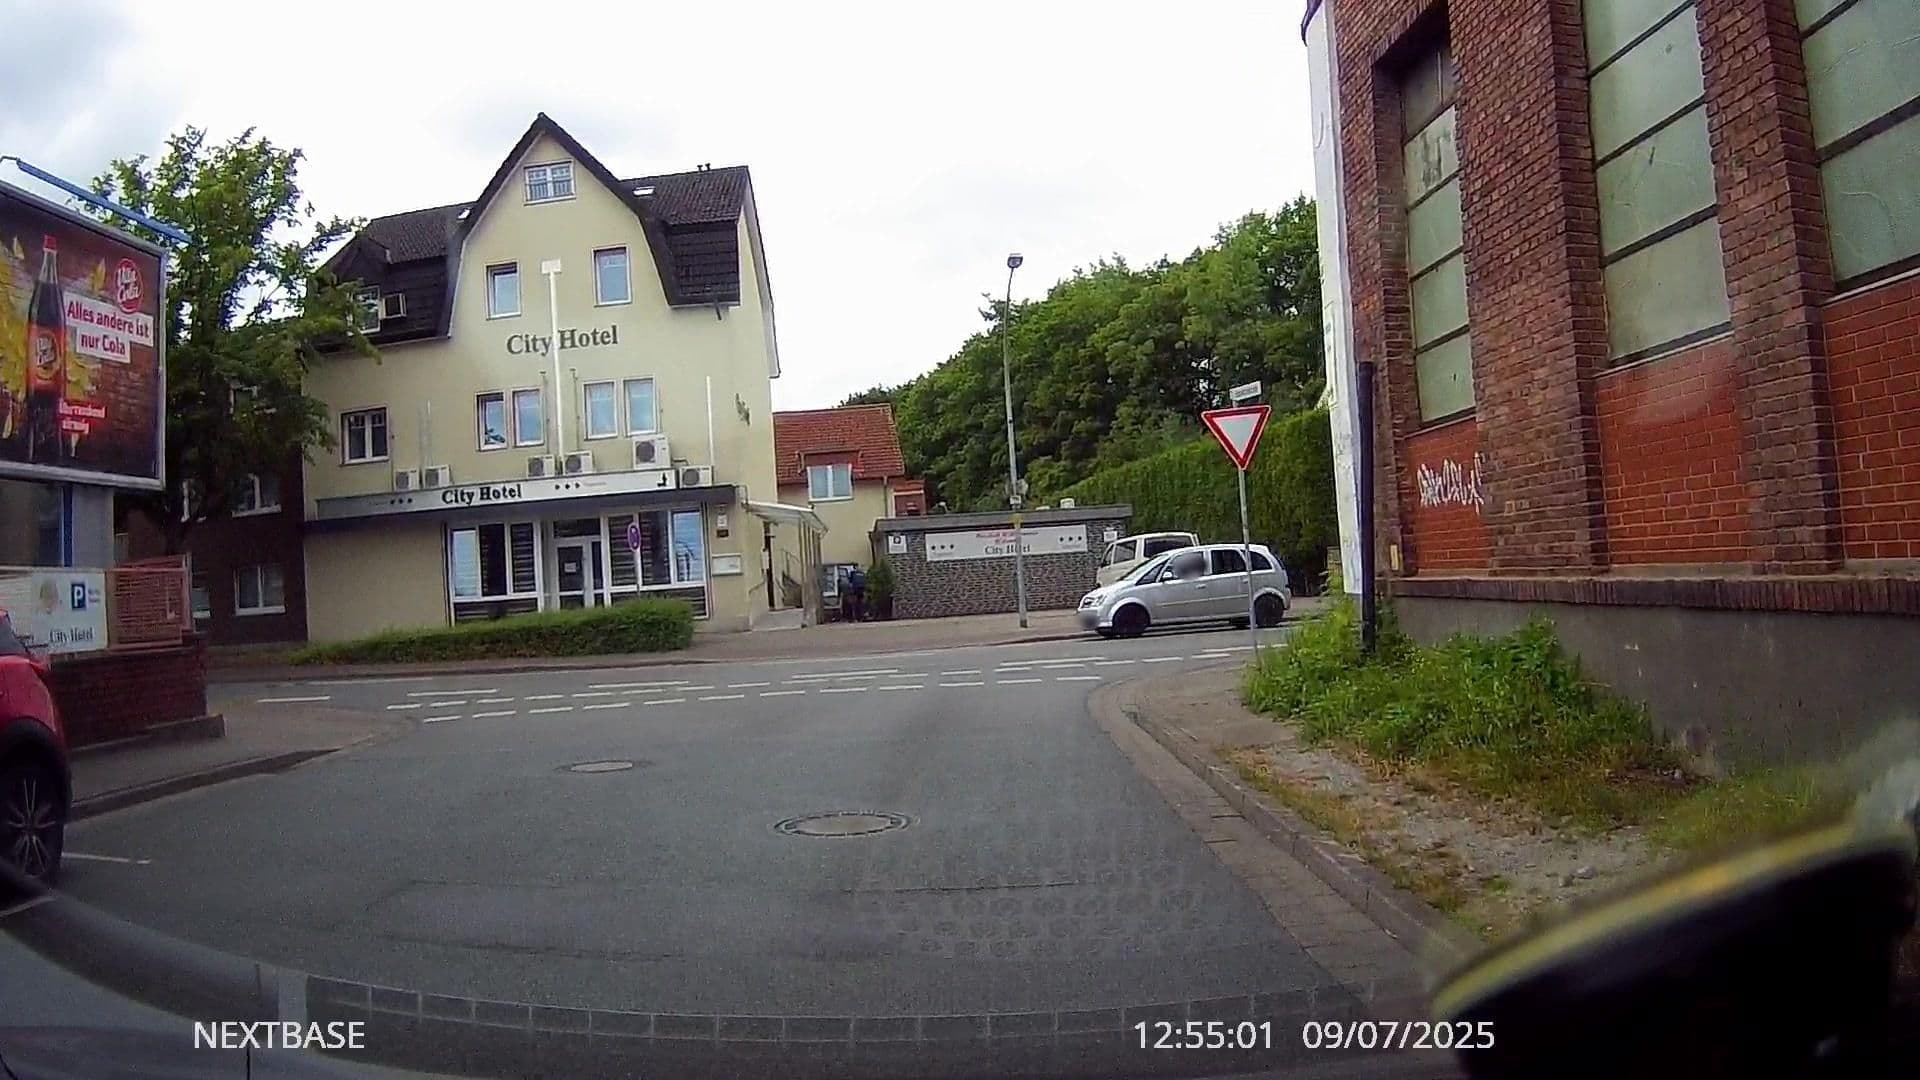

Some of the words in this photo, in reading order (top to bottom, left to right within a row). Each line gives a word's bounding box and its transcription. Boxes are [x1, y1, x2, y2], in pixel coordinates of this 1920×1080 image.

[67, 300, 94, 323] Alles
[96, 312, 134, 334] andere
[136, 318, 150, 338] ist
[80, 334, 99, 348] nur
[102, 334, 126, 355] Cola
[507, 334, 552, 357] City
[558, 324, 618, 350] Hotel
[441, 489, 474, 505] City
[480, 483, 521, 501] Hotel
[49, 629, 68, 643] City
[70, 626, 94, 641] Hotel
